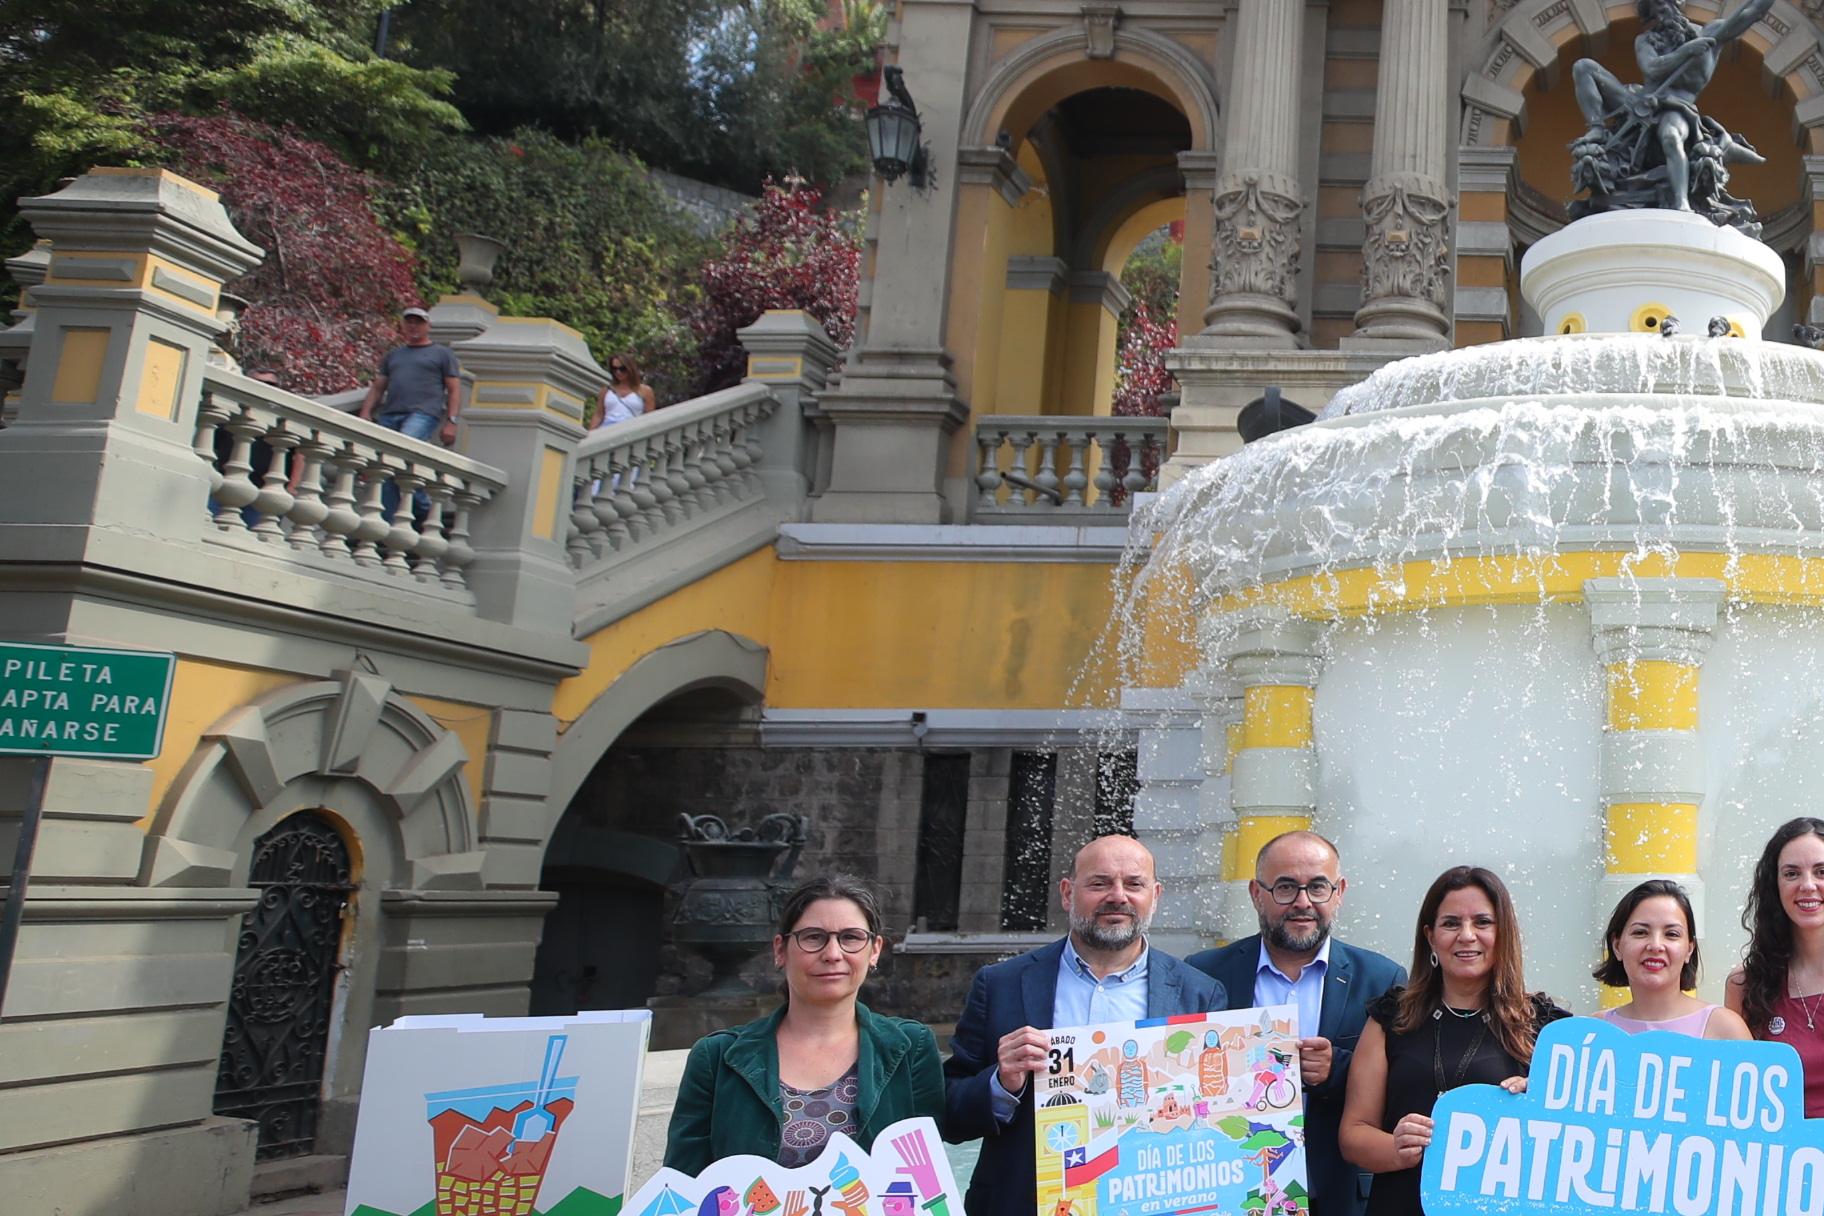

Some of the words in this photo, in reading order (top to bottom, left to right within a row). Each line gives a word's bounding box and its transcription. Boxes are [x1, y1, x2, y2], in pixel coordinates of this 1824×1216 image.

[4, 659, 113, 685] PILETA
[1, 689, 70, 711] APTA
[91, 693, 157, 716] PARA
[0, 718, 121, 742] AÑARSE
[1051, 1035, 1076, 1046] ÁBADO
[1048, 1047, 1075, 1075] 31
[1048, 1075, 1076, 1089] ENERO
[1543, 1032, 1617, 1115] DÍA
[1633, 1052, 1694, 1123] DE
[1705, 1059, 1789, 1133] LOS
[1137, 1143, 1162, 1172] DÍA
[1166, 1143, 1185, 1168] DE
[1189, 1139, 1216, 1164] LOS
[1141, 1201, 1162, 1213] en
[1165, 1191, 1218, 1210] verano
